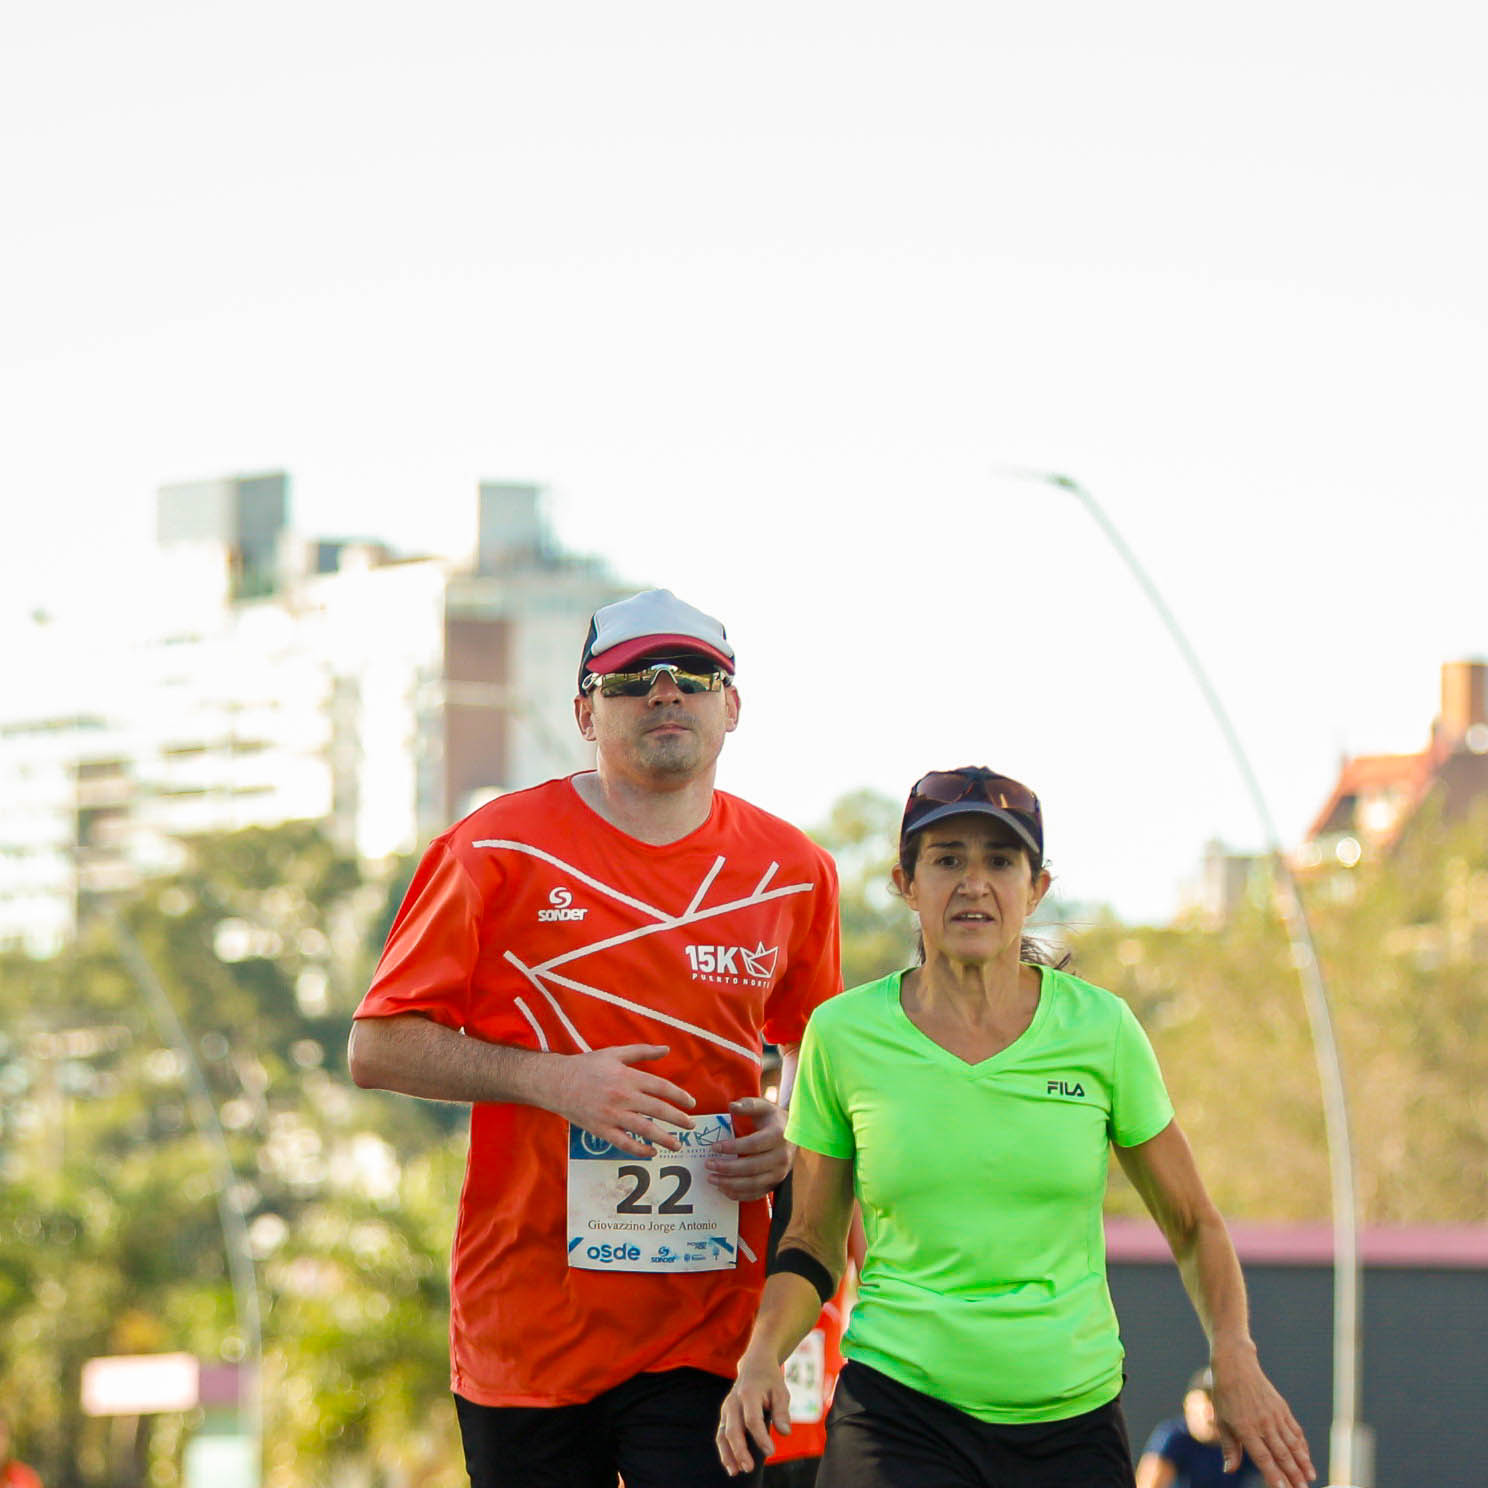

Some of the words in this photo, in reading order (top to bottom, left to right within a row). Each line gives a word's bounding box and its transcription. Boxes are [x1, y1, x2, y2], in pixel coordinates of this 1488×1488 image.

[685, 945, 738, 974] 15K
[692, 972, 738, 985] PUERTO
[1047, 1081, 1085, 1097] FILA
[617, 1165, 693, 1214] 22
[587, 1219, 646, 1231] Giovazzino
[648, 1221, 676, 1233] Jorge
[678, 1220, 717, 1231] Antonio
